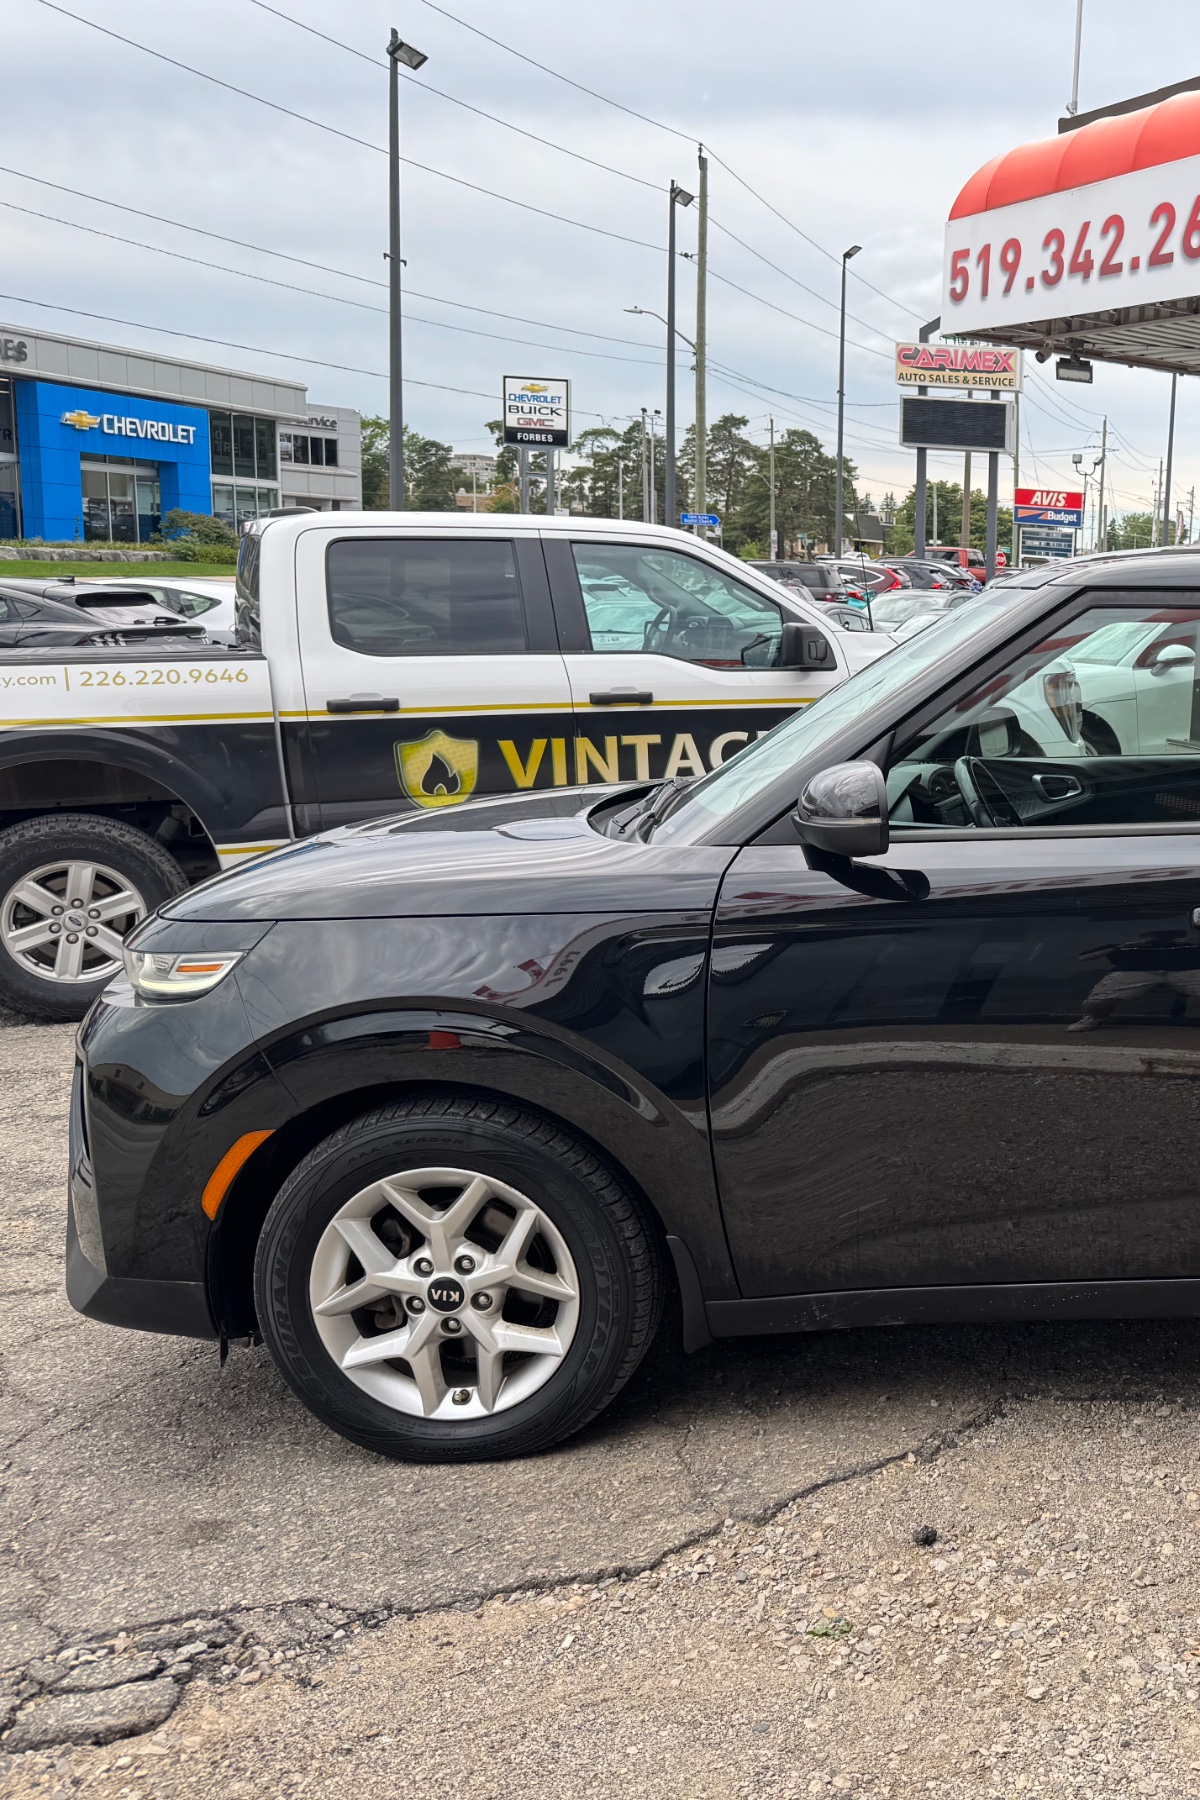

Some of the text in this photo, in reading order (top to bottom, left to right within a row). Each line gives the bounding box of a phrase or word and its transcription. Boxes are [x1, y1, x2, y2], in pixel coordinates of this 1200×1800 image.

[897, 346, 1016, 372] CARIMEX
[898, 372, 1014, 387] AUTO SALES & SERVICE
[508, 393, 562, 404] CHEVROLET
[508, 405, 562, 416] BUICK
[103, 414, 196, 444] CHEVROLET
[517, 417, 554, 427] GMC
[517, 432, 553, 442] FORBES
[1030, 491, 1067, 507] AVIS
[1047, 511, 1077, 524] Budget
[0, 675, 57, 687] y.com
[79, 668, 249, 687] 226.220.9646
[544, 1181, 609, 1374] GOODYEAR
[431, 1289, 460, 1302] KIA
